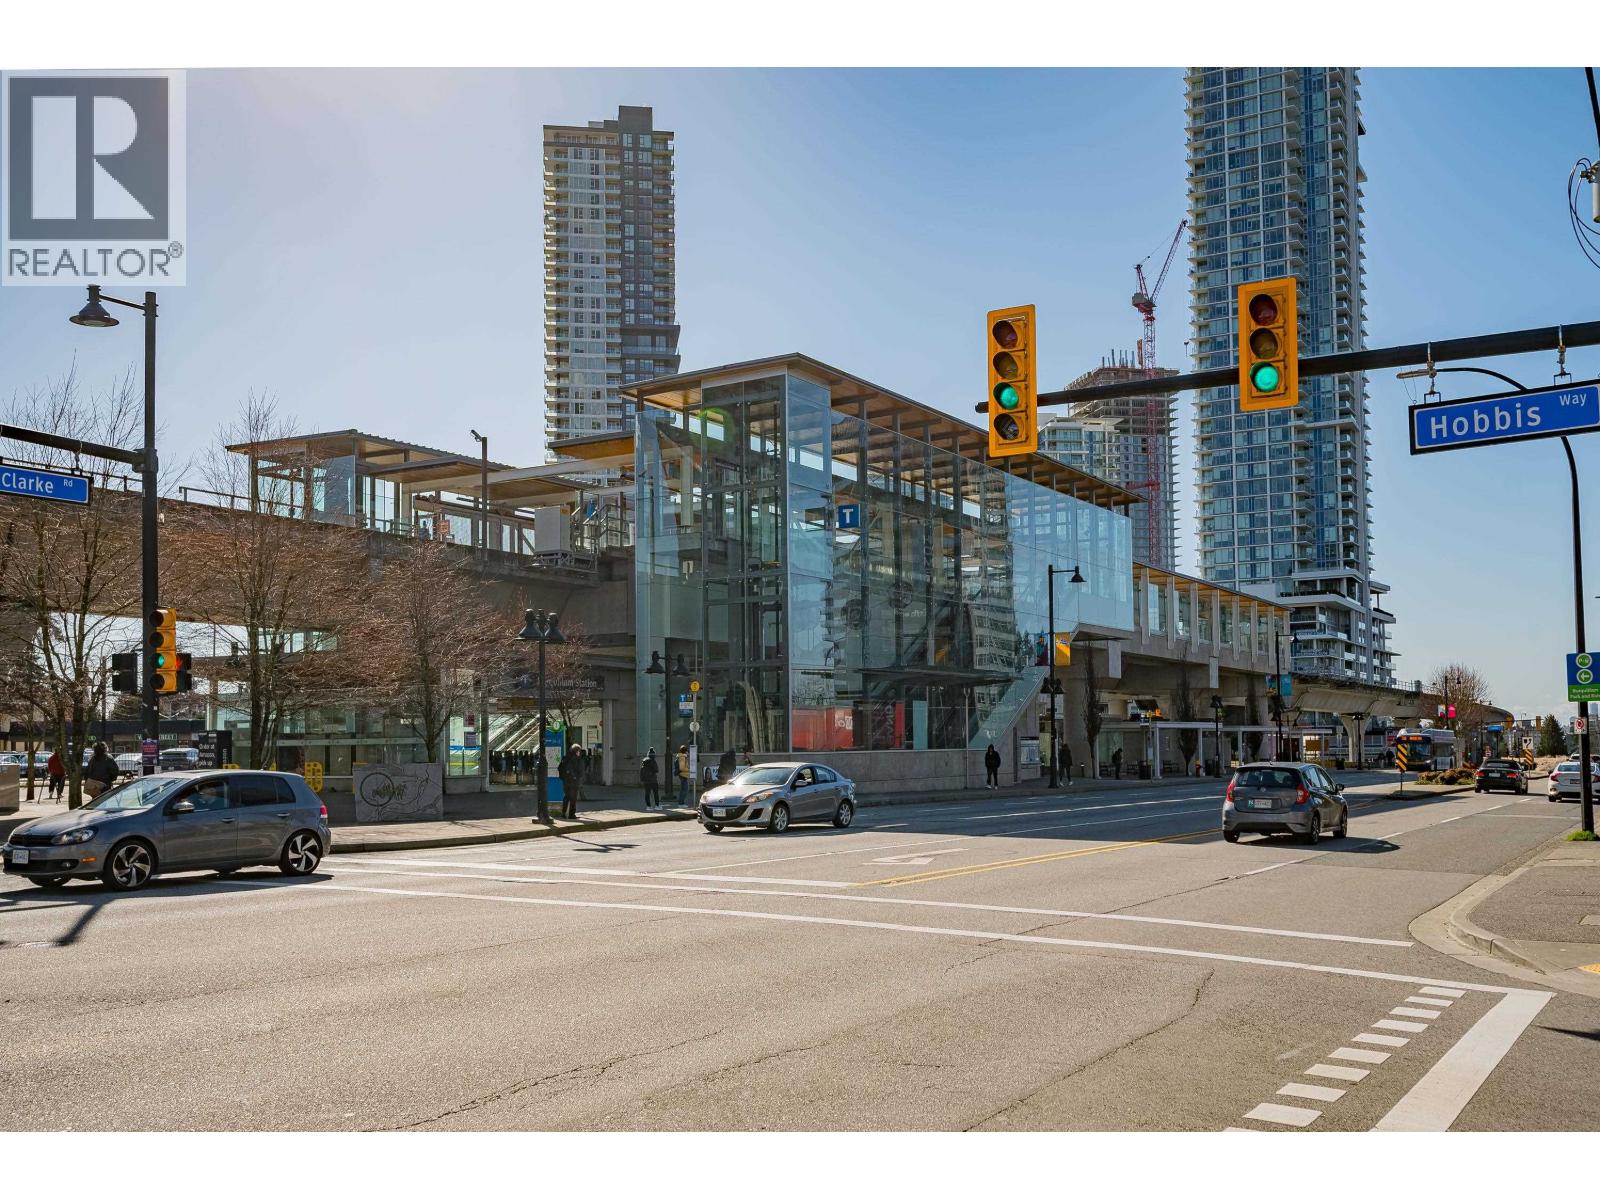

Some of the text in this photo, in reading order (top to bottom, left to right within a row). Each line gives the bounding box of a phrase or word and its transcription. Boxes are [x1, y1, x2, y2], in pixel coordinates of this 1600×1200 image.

[1430, 393, 1587, 439] Hobbis Way
[1, 472, 73, 494] Clarke Rd
[842, 508, 854, 524] T
[576, 678, 597, 688] Station
